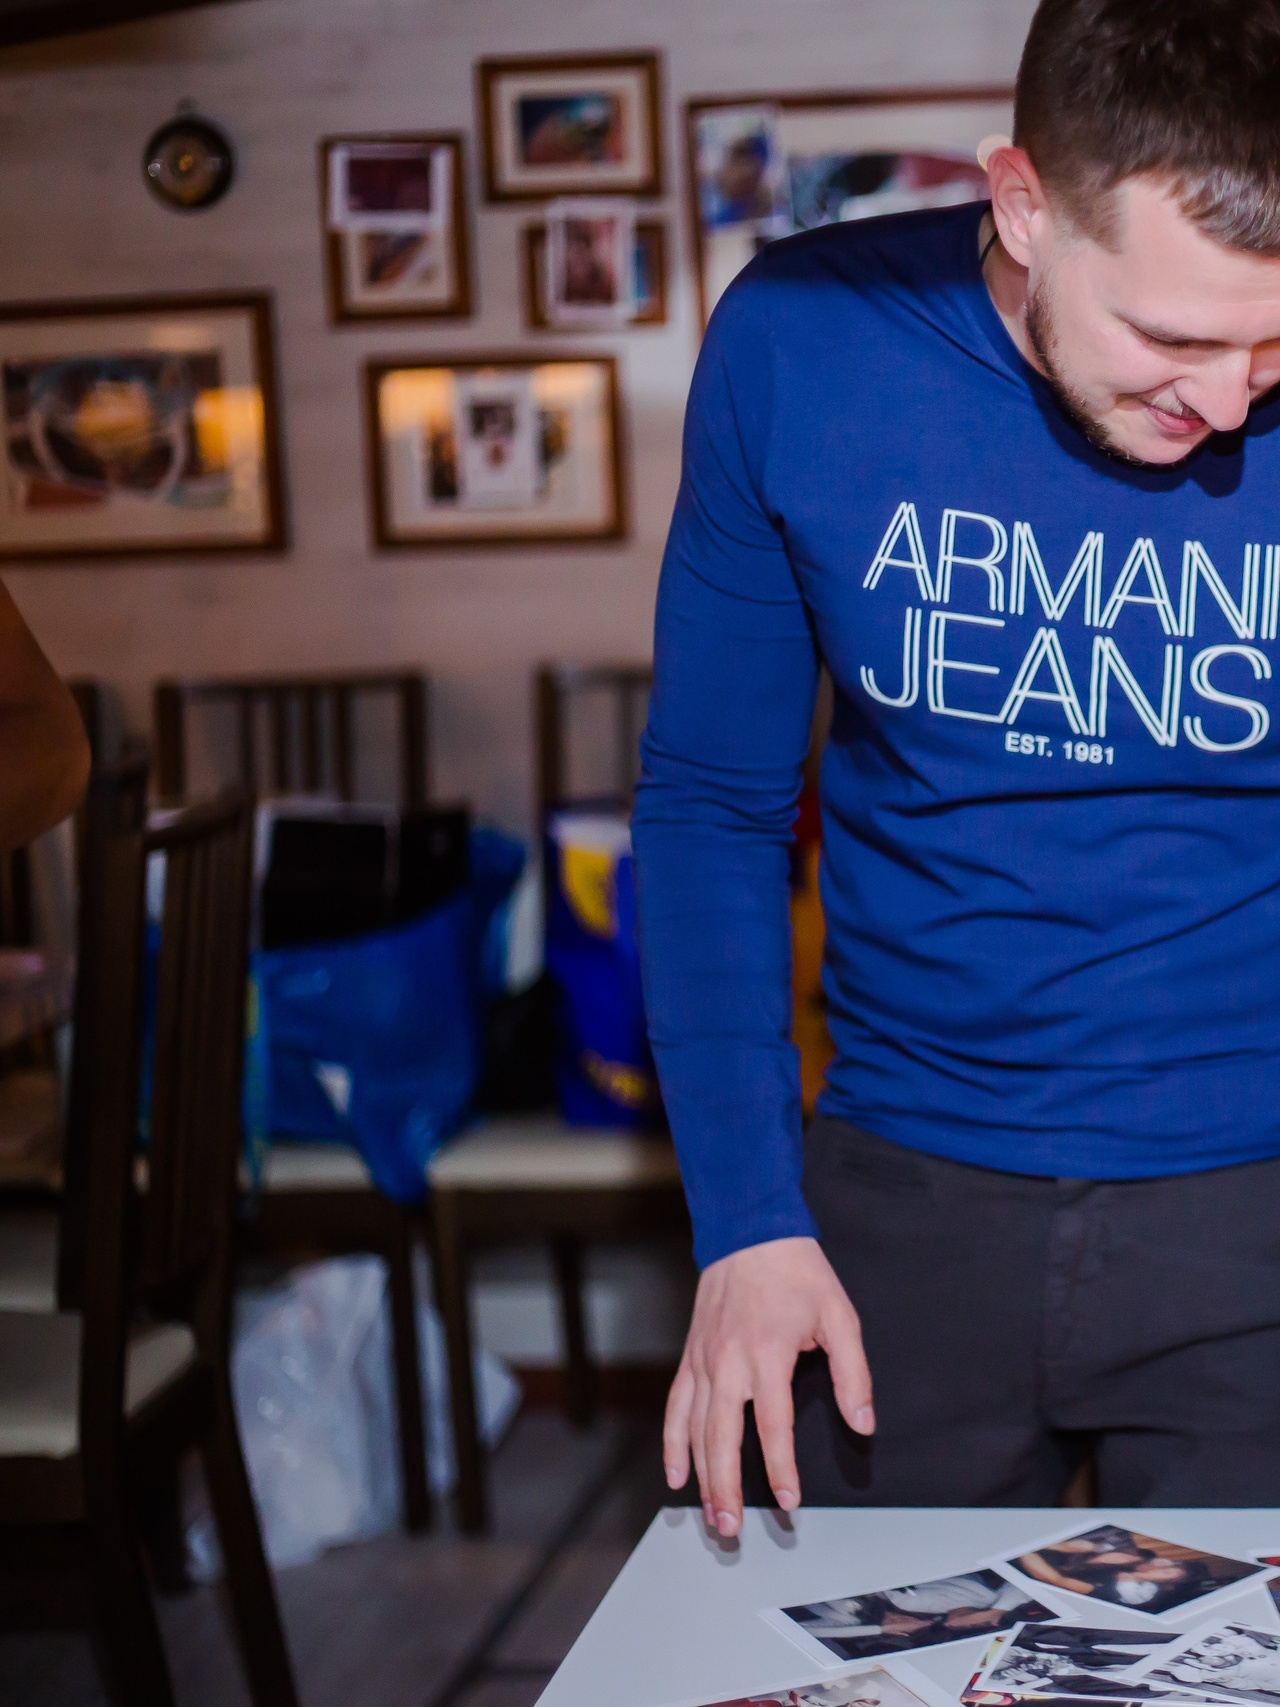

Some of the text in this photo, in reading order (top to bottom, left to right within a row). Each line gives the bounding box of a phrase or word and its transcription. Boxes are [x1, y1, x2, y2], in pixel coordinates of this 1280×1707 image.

[860, 606, 1273, 752] JEANS
[1005, 731, 1114, 766] EST. 1981
